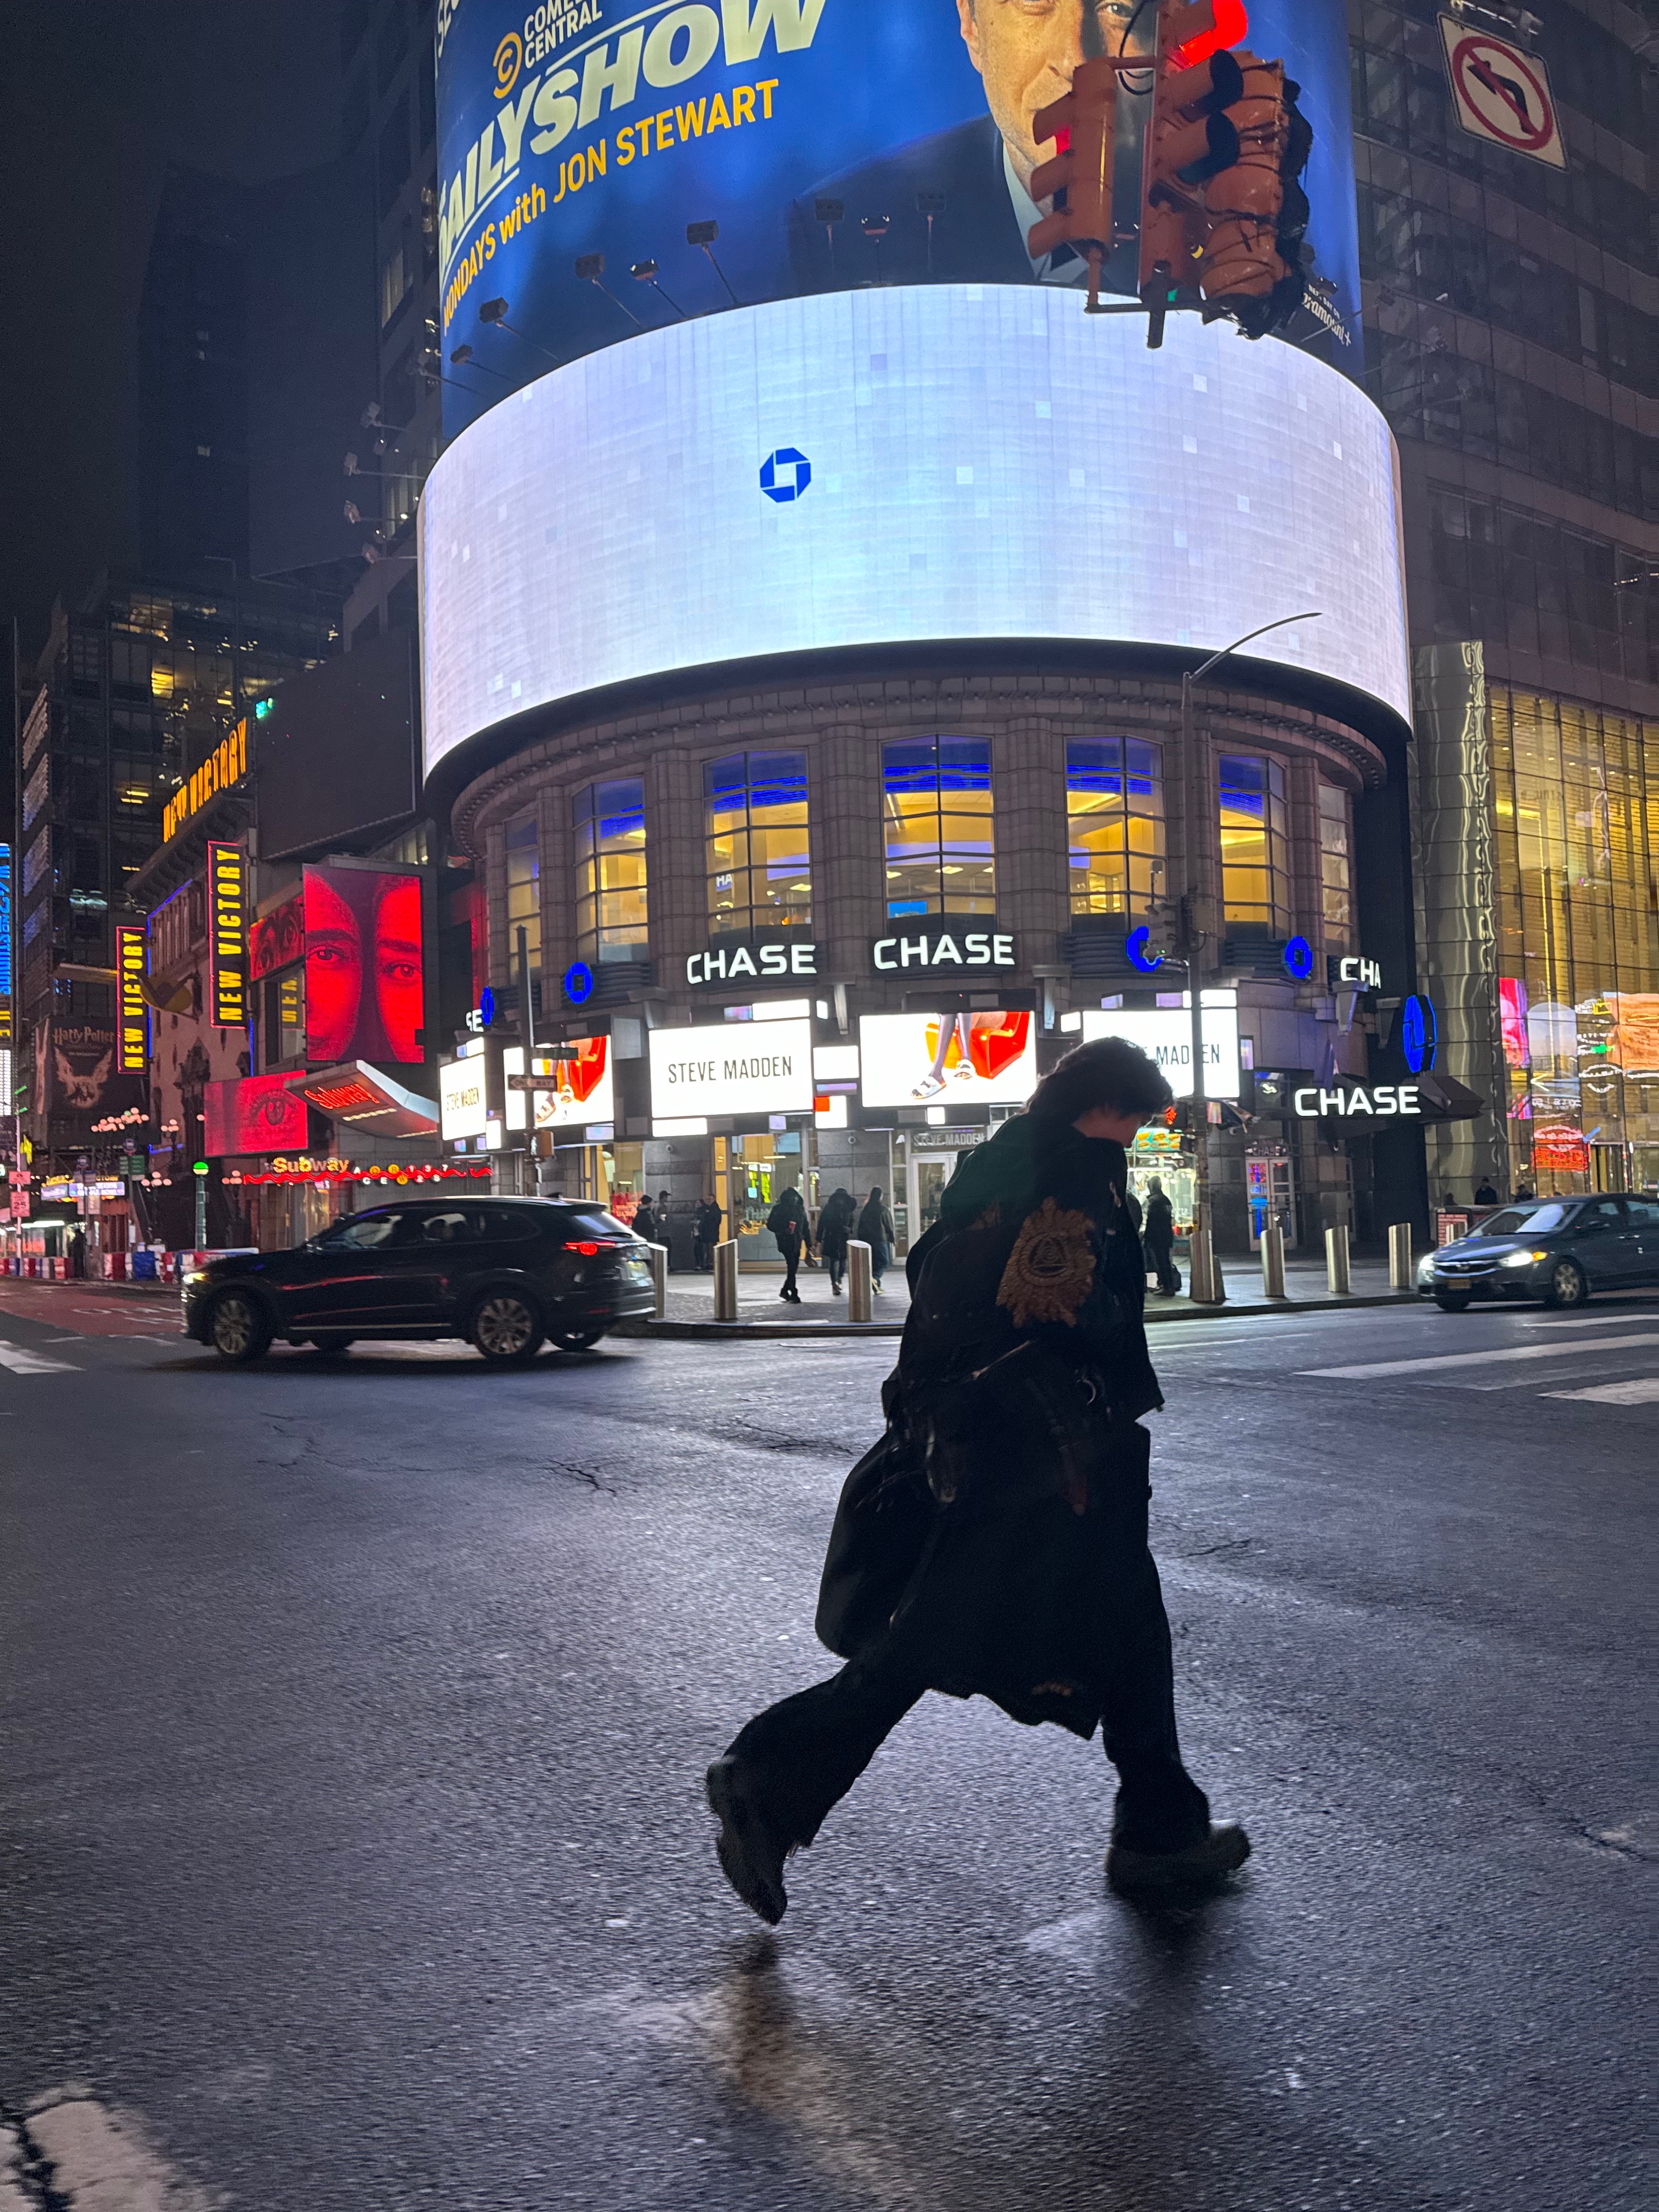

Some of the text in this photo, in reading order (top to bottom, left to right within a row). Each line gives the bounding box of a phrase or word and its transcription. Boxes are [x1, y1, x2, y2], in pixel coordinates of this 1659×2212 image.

[525, 1, 602, 69] CENTRAL
[444, 78, 778, 337] MONDAYS with JON STEWART
[1302, 292, 1351, 347] ramount+
[163, 716, 246, 843] NEW VICTORY
[217, 849, 242, 1021] NEW VICTORY
[687, 944, 817, 984] CHASE
[874, 934, 1015, 969] CHASE
[1340, 957, 1381, 989] CHA
[123, 932, 143, 1068] NEW VICTORY
[52, 1026, 115, 1046] Harry Potter
[668, 1056, 792, 1084] STEVE MADDEN
[1156, 1044, 1220, 1065] MADEN
[304, 1083, 380, 1110] Subway
[1295, 1086, 1421, 1116] CHASE
[945, 1132, 985, 1146] MADDEN
[273, 1156, 349, 1173] Subway
[380, 1176, 387, 1184] E
